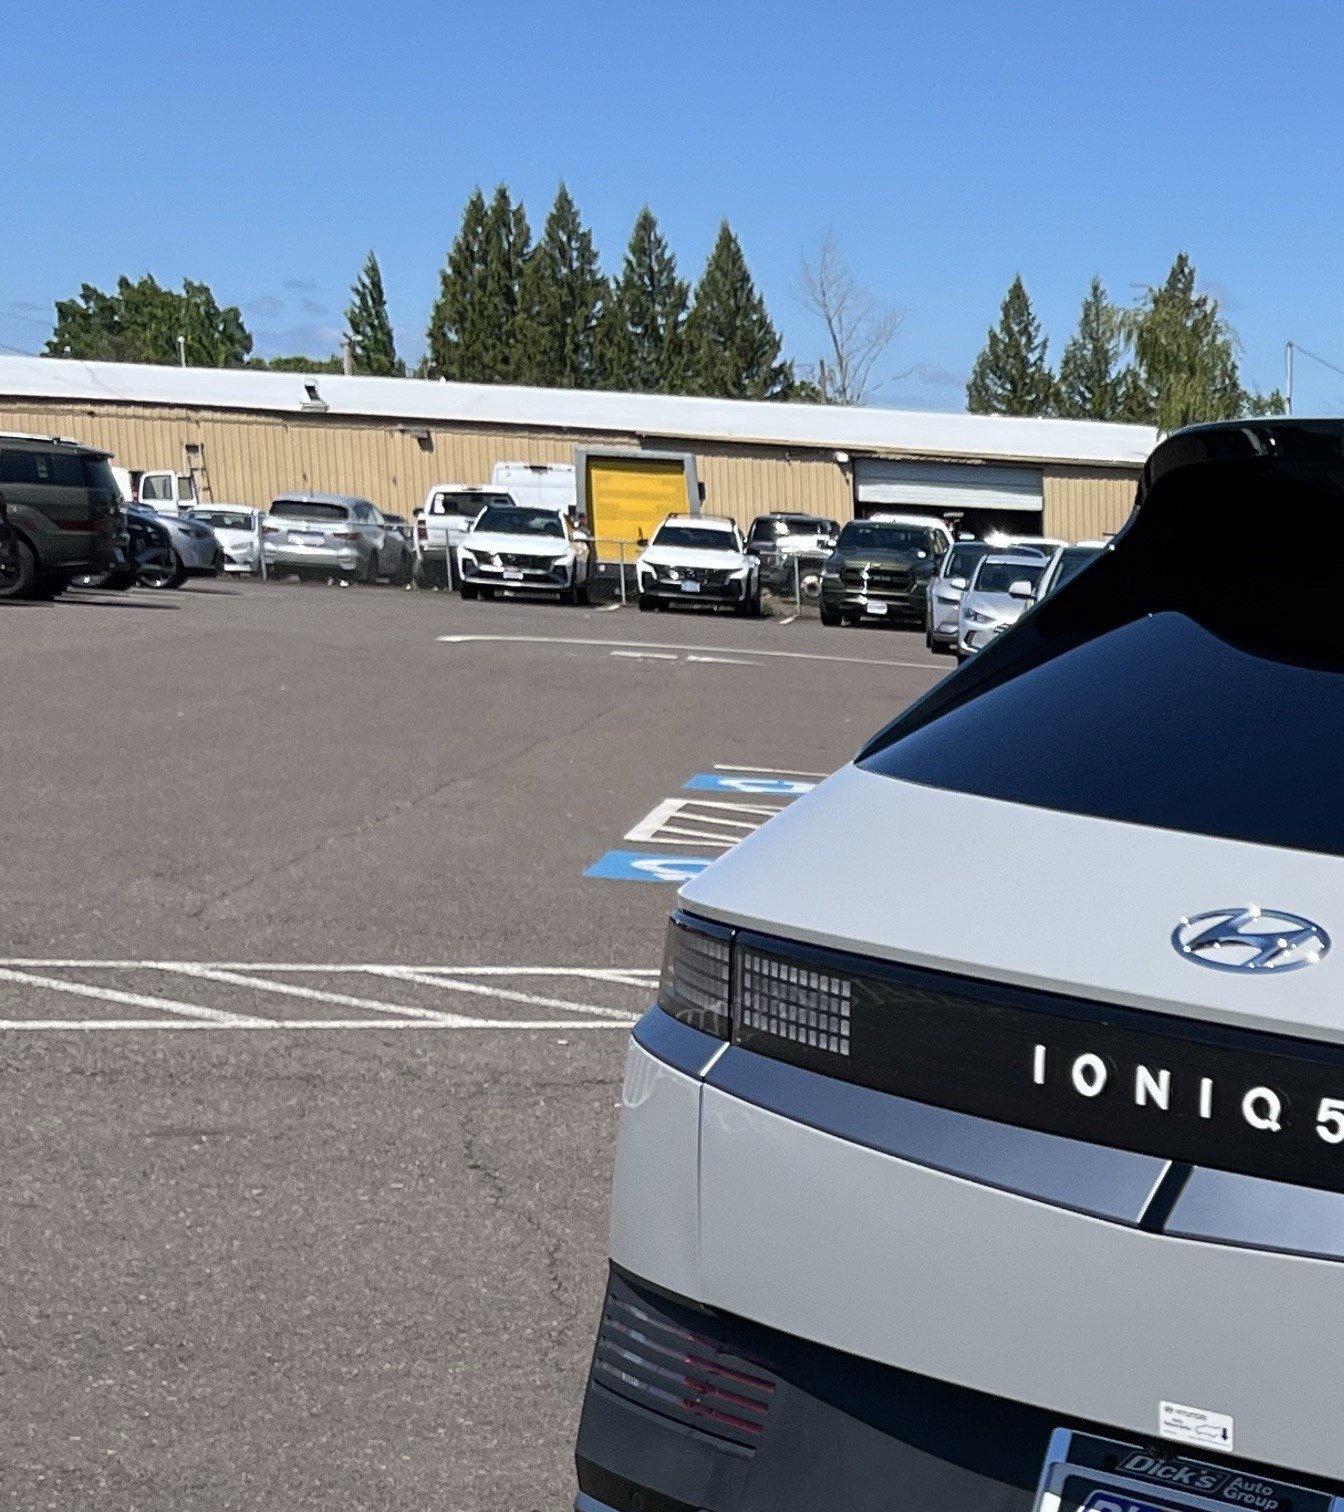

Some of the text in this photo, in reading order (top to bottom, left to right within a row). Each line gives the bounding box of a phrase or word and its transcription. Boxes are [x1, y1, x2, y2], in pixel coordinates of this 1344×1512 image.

[1033, 1044, 1282, 1132] IONIQ
[1124, 1455, 1217, 1489] Dick's
[1223, 1486, 1279, 1510] Group
[1231, 1477, 1274, 1497] Auto
